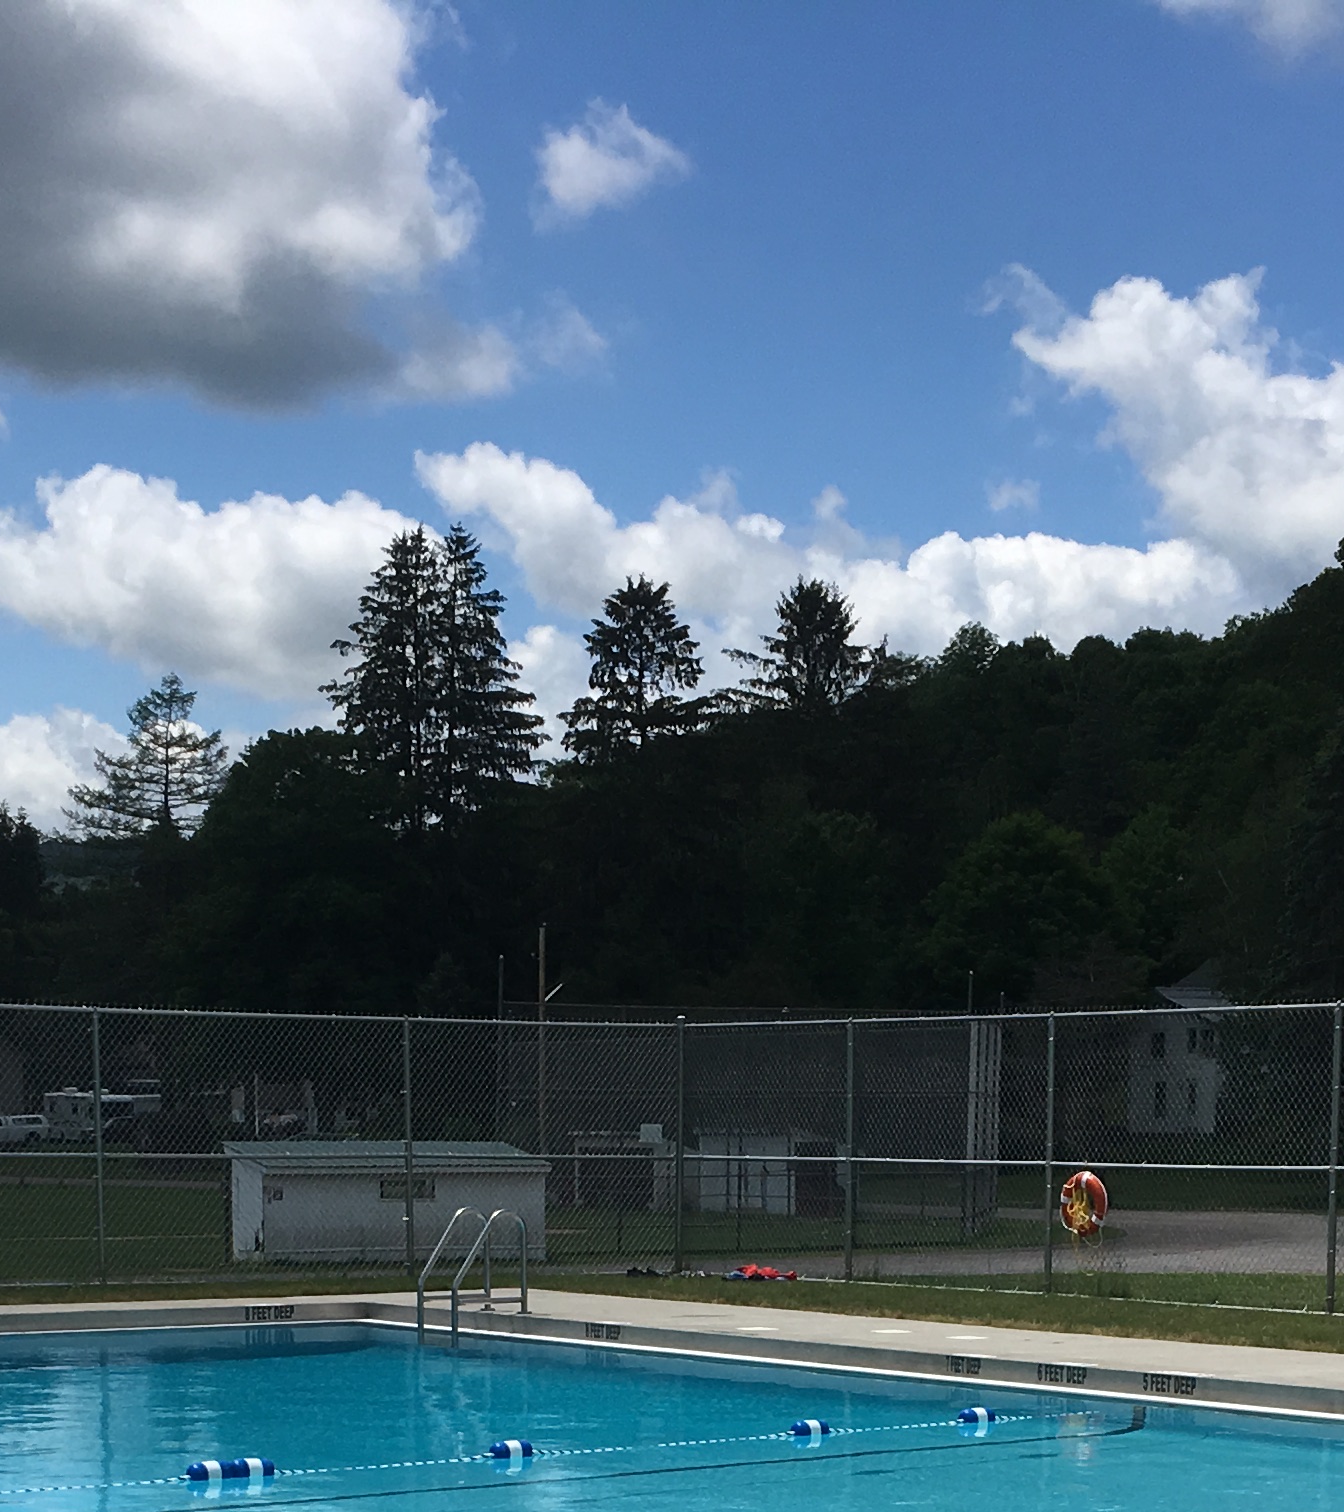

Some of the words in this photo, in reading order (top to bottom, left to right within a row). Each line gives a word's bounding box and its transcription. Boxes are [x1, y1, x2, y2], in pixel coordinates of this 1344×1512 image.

[252, 1306, 271, 1320] FEET
[274, 1305, 294, 1319] DEEP
[1038, 1363, 1043, 1381] 6
[1045, 1364, 1064, 1382] FEET
[1066, 1366, 1087, 1384] DEEP
[1143, 1373, 1148, 1391] 5
[1150, 1373, 1171, 1392] FEET
[1174, 1376, 1197, 1395] DEEP
